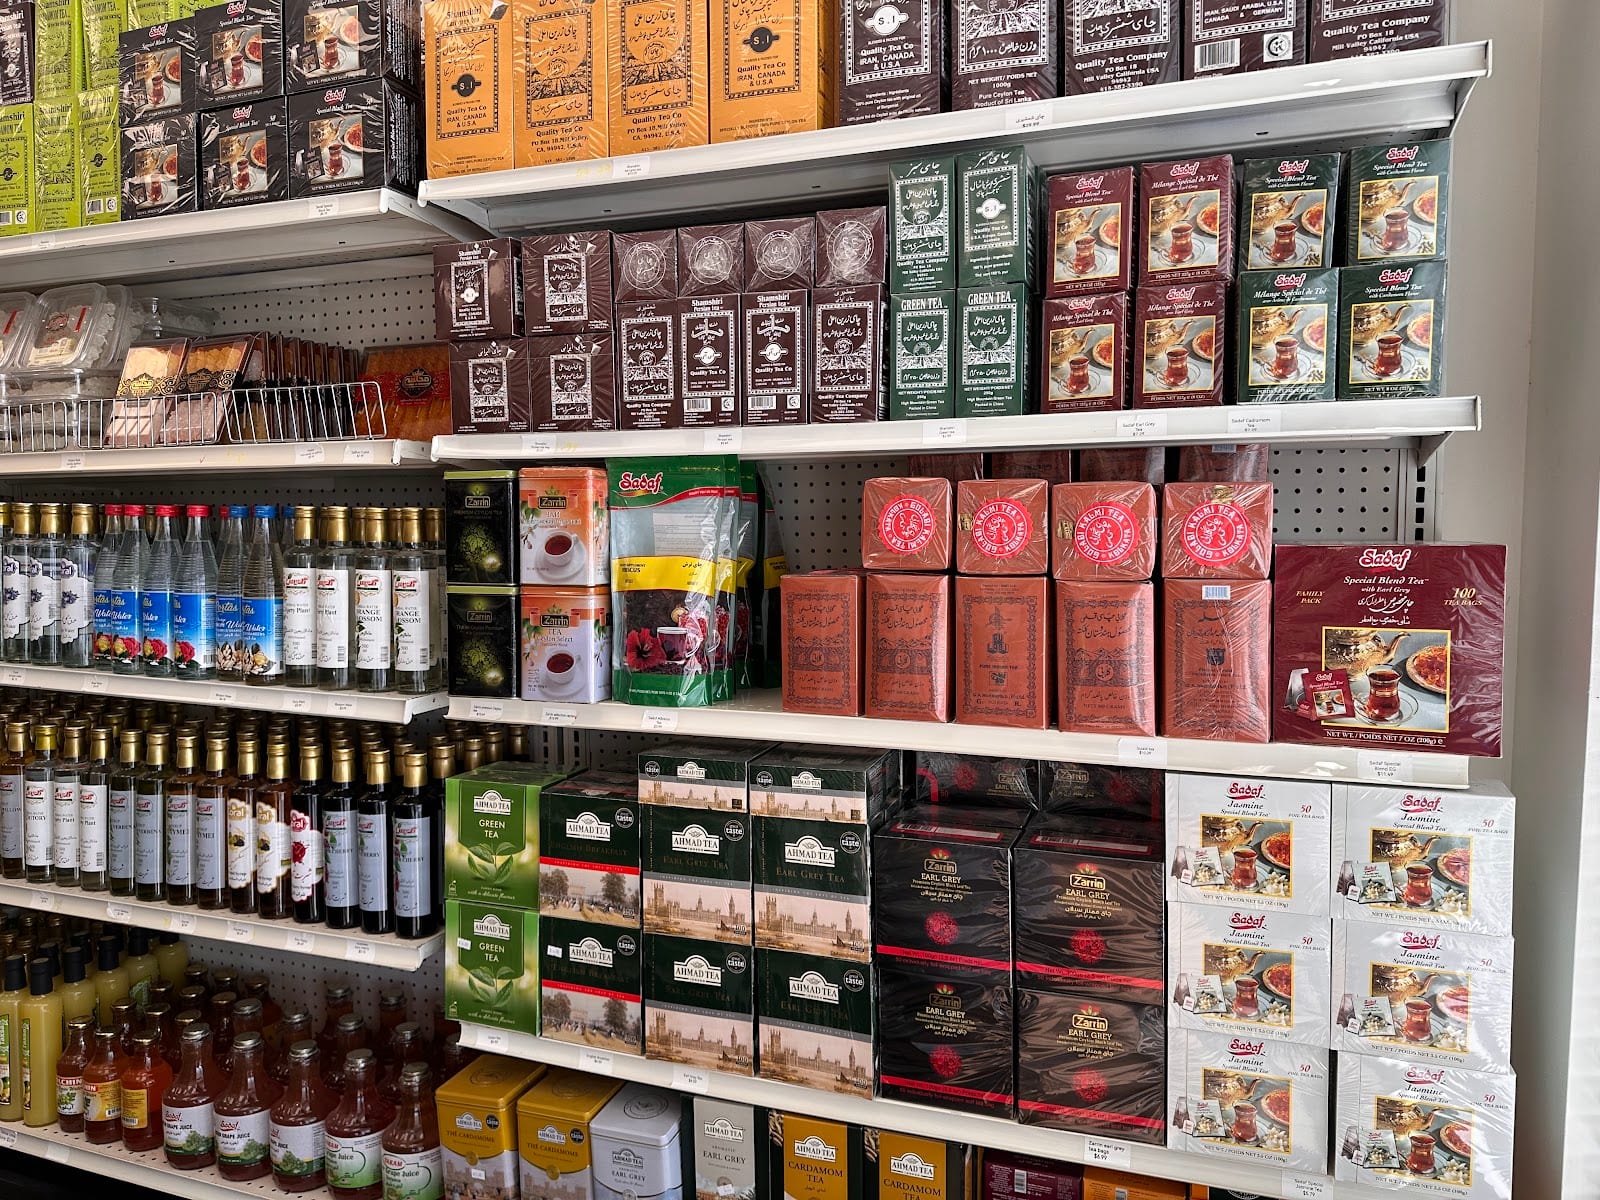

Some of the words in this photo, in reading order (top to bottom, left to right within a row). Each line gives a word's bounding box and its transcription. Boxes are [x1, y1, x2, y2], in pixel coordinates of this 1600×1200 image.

[226, 1, 247, 15] Sadaf
[1204, 15, 1230, 24] CANADA
[1253, 7, 1284, 16] GERMANY
[860, 45, 887, 57] Quality
[889, 44, 903, 52] Tea
[904, 42, 914, 50] Co
[1346, 41, 1367, 50] Valley
[1369, 36, 1404, 47] California
[882, 52, 915, 63] CANADA
[1075, 61, 1106, 71] Quality
[1126, 50, 1169, 61] Company
[737, 64, 761, 73] Quality
[757, 70, 786, 78] CANADA
[1096, 73, 1115, 81] Valley
[1116, 70, 1145, 78] California
[325, 88, 346, 102] Sadaf
[978, 92, 992, 100] Pure
[993, 90, 1014, 99] Ceylon
[232, 106, 252, 118] Sadaf
[447, 108, 466, 116] Quality
[632, 115, 656, 124] Quality
[536, 129, 559, 137] Quality
[1386, 146, 1418, 162] Sadaf
[1170, 162, 1200, 177] Sadaf
[1278, 160, 1309, 174] Sadaf
[1152, 177, 1176, 189] Mélange
[1176, 176, 1197, 186] Spécial
[1198, 175, 1206, 183] de
[1208, 174, 1220, 182] Thé
[1274, 273, 1307, 288] Sadaf
[1379, 268, 1413, 284] Sadaf
[757, 294, 790, 303] Shamshiri
[968, 292, 994, 305] GREEN
[996, 291, 1011, 303] TEA
[1166, 287, 1196, 301] Sadaf
[691, 299, 723, 308] Shamshiri
[901, 298, 925, 311] GREEN
[927, 297, 943, 309] TEA
[619, 471, 664, 496] Sadaf
[468, 498, 490, 507] Zarrin
[540, 498, 566, 507] Zarrin
[1359, 549, 1412, 570] Sadaf
[1344, 576, 1377, 584] Special
[1378, 576, 1403, 584] Blend
[1393, 586, 1410, 594] Grey
[1452, 588, 1475, 598] 100
[1228, 781, 1264, 799] Sadaf
[474, 800, 497, 813] AHMAD
[498, 800, 512, 813] TEA
[1227, 800, 1264, 810] Jasmine
[1300, 804, 1312, 814] 50
[1402, 794, 1441, 811] Sadaf
[478, 819, 506, 830] GREEN
[615, 814, 634, 823] taste
[1401, 813, 1440, 824] Jasmine
[1481, 818, 1494, 829] 50
[484, 829, 500, 840] TEA
[567, 823, 592, 837] AHMAD
[593, 826, 611, 838] TEA
[672, 835, 698, 848] AHMAD
[699, 838, 719, 850] TEA
[785, 846, 813, 860] AHMAD
[814, 850, 835, 862] TEA
[927, 860, 955, 873] Zarrin
[921, 873, 940, 881] EARL
[942, 876, 961, 884] GREY
[1072, 877, 1103, 889] Zarrin
[1066, 888, 1086, 897] EARL
[1088, 891, 1110, 900] GREY
[1230, 912, 1266, 928] Sadaf
[473, 924, 497, 937] AHMAD
[497, 926, 510, 938] TEA
[1230, 930, 1265, 941] Jasmine
[1302, 936, 1313, 946] 50
[1402, 932, 1441, 948] Sadaf
[478, 942, 506, 953] GREEN
[484, 952, 500, 963] TEA
[569, 948, 595, 962] AHMAD
[596, 951, 613, 964] TEA
[1400, 949, 1440, 962] Jasmine
[1480, 958, 1493, 968] 50
[674, 966, 701, 980] AHMAD
[702, 970, 721, 982] TEA
[926, 1007, 945, 1016] EARL
[946, 1010, 966, 1019] GREY
[1075, 1016, 1106, 1029] Zarrin
[1068, 1029, 1088, 1038] EARL
[1091, 1032, 1112, 1041] GREY
[1230, 1038, 1264, 1054] Sadaf
[1228, 1056, 1264, 1067] Jasmine
[1299, 1064, 1312, 1073] 50
[1406, 1066, 1445, 1084] Sadaf
[1405, 1083, 1444, 1096] Jasmine
[1483, 1093, 1496, 1103] 50
[704, 1125, 727, 1137] AHMAD
[728, 1128, 744, 1139] TEA
[795, 1144, 816, 1155] AHMAD
[816, 1147, 836, 1158] TEA
[703, 1151, 723, 1163] EARL
[724, 1154, 746, 1166] GREY
[788, 1160, 843, 1178] CARDAMOM
[891, 1160, 912, 1172] AHMAD
[912, 1164, 933, 1177] TEA
[884, 1178, 941, 1197] CARDAMOM
